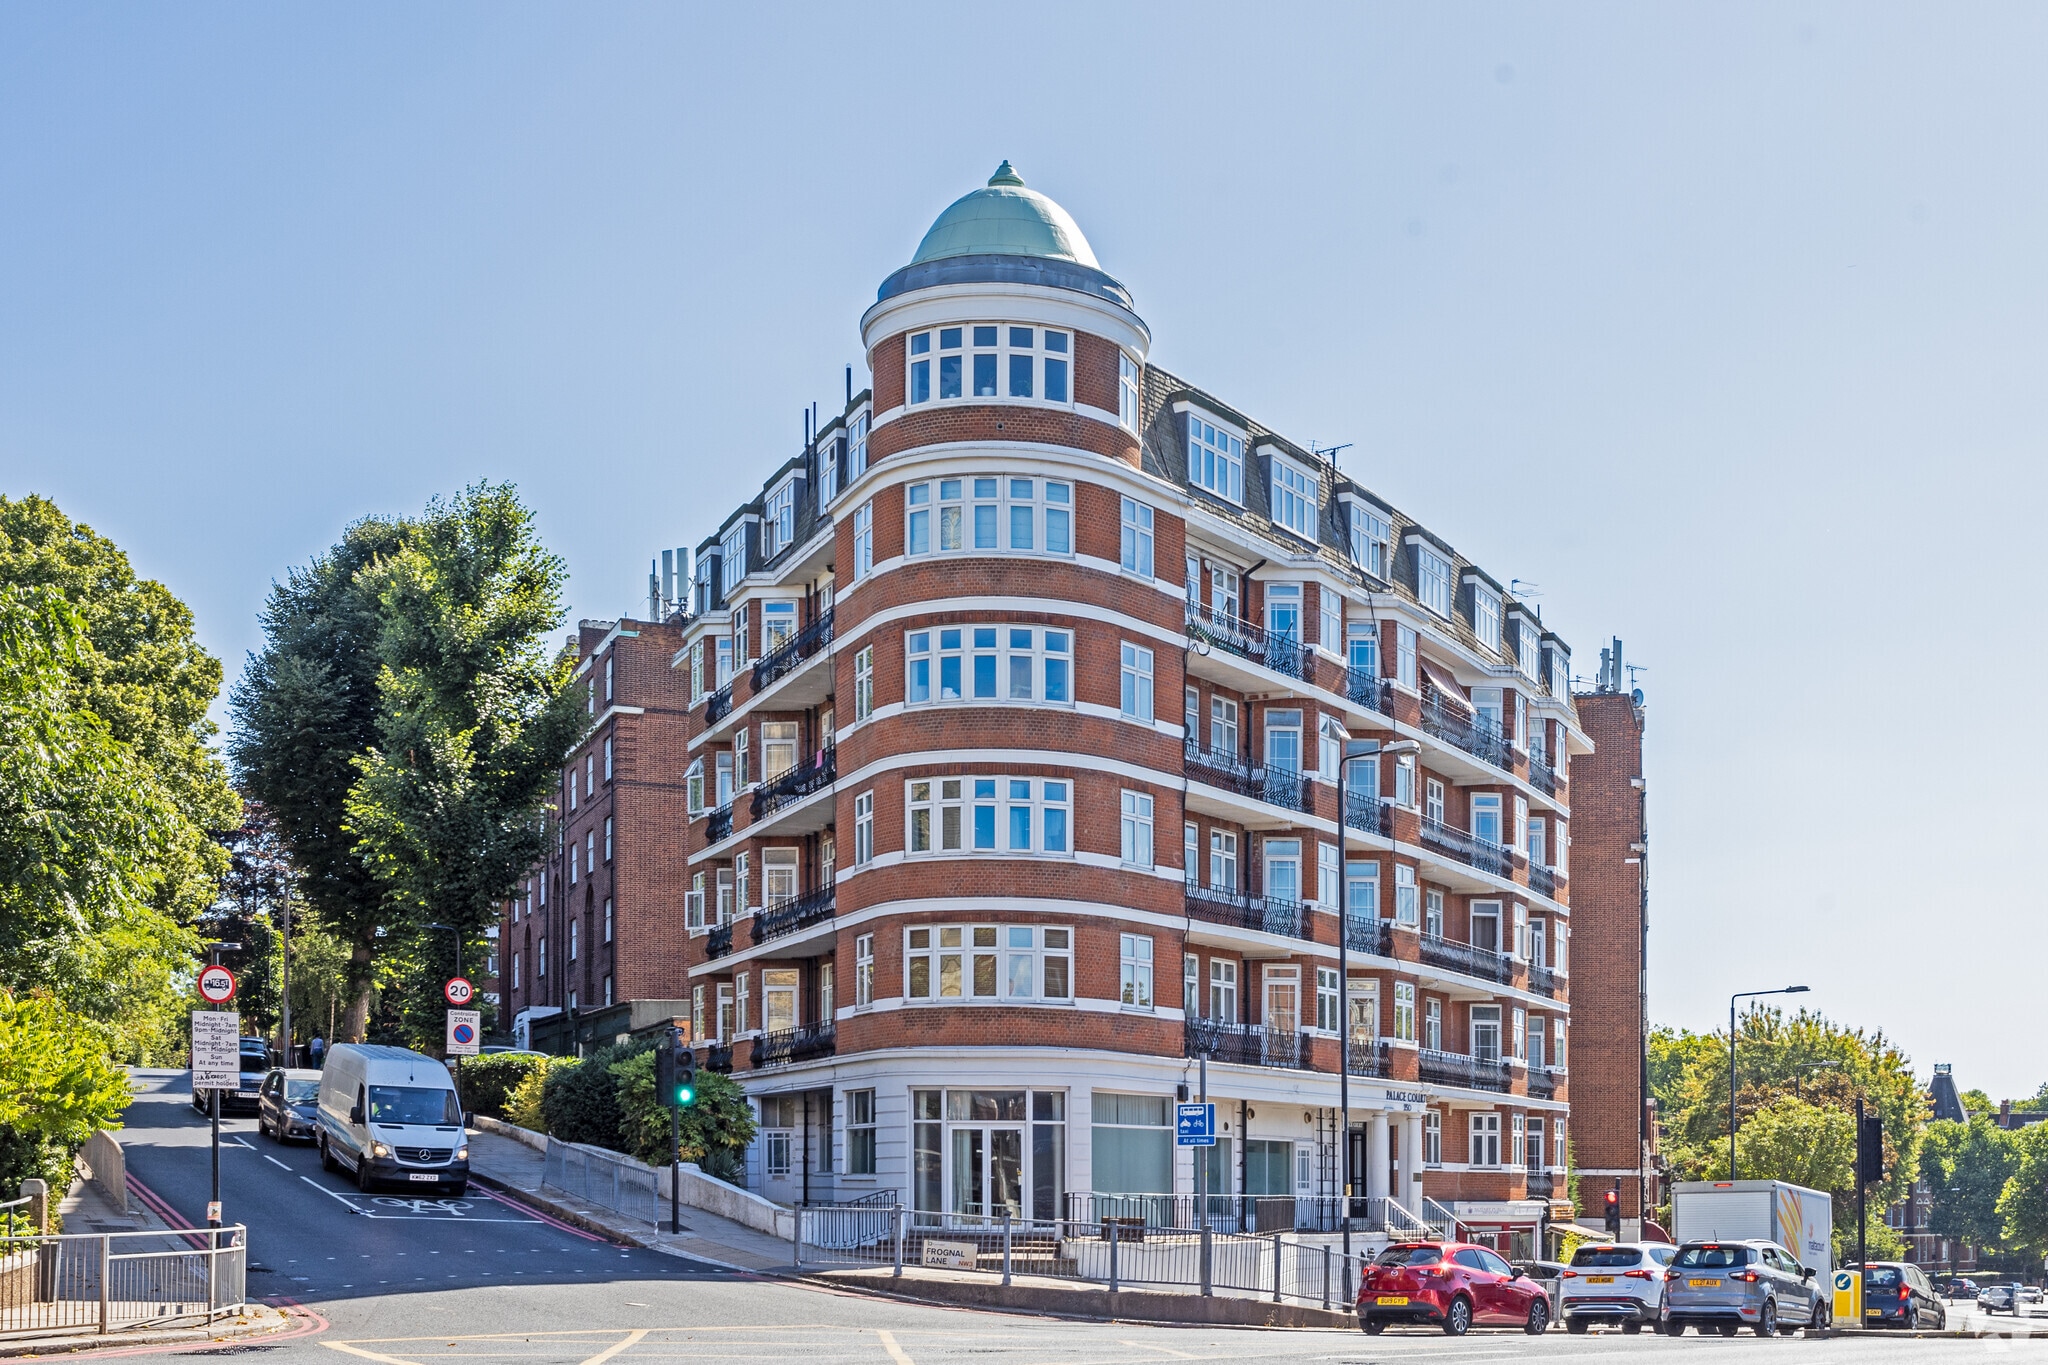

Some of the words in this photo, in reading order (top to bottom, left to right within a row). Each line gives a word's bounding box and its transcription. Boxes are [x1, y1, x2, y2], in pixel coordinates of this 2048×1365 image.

[450, 986, 469, 997] 20
[1386, 1090, 1406, 1101] PALACE
[1408, 1092, 1426, 1103] COURT
[926, 1248, 965, 1257] FROGNAL
